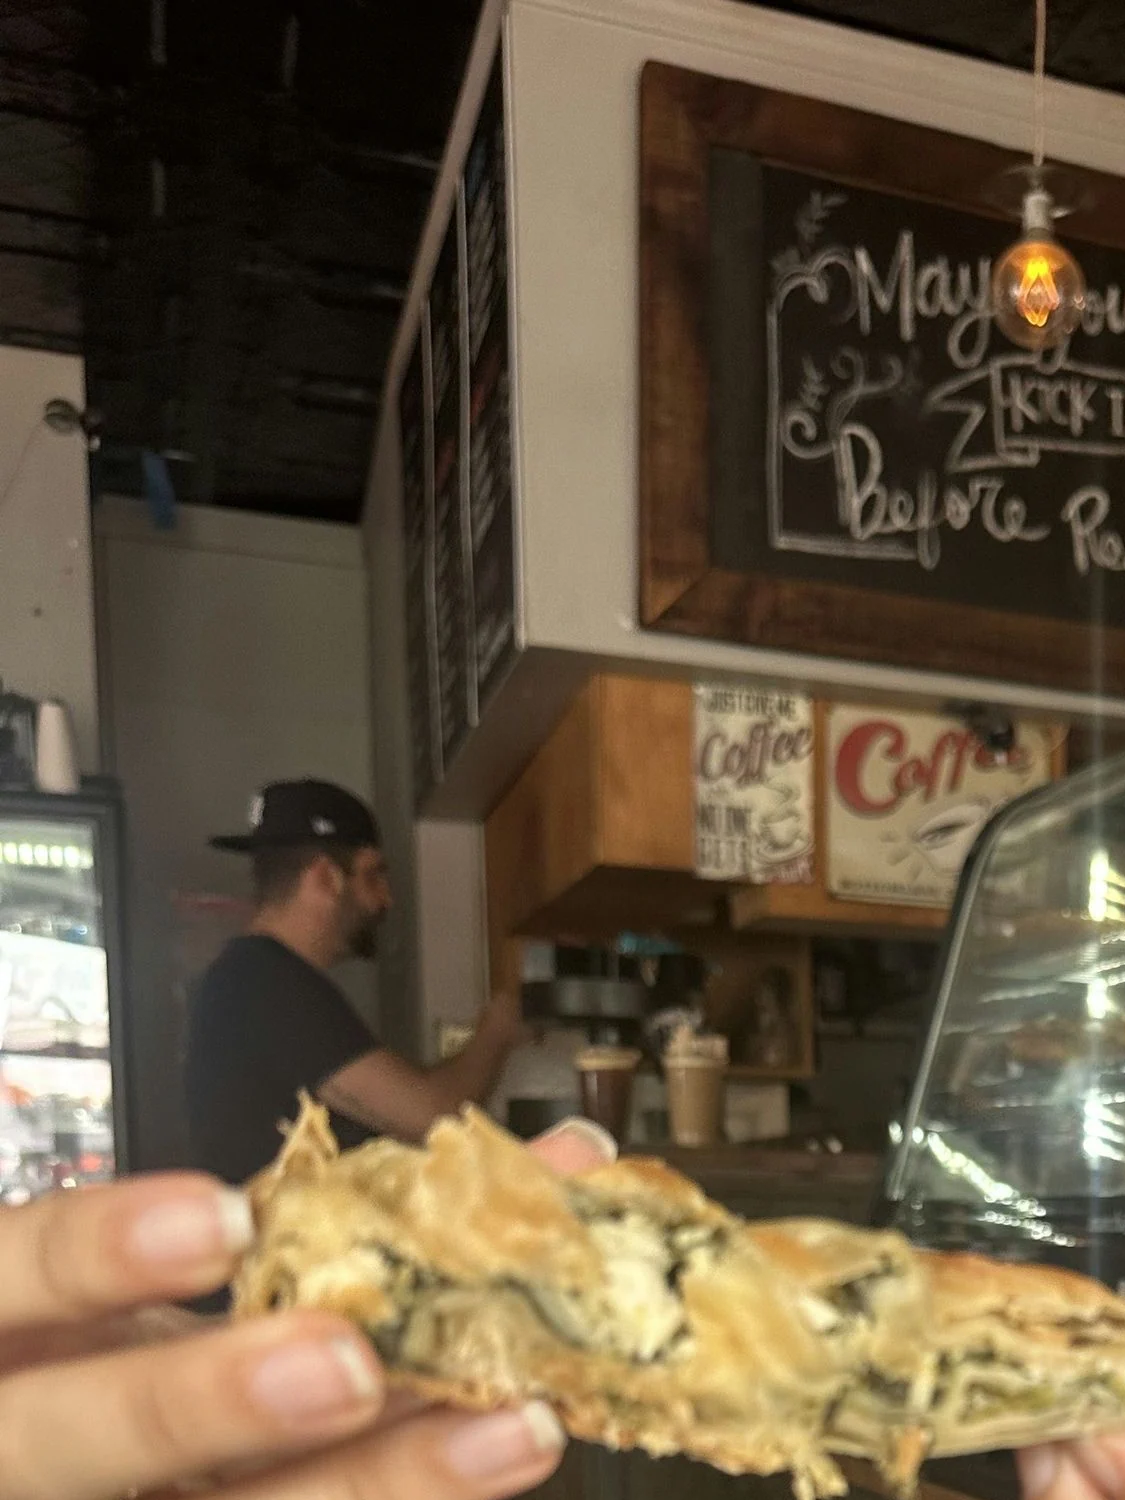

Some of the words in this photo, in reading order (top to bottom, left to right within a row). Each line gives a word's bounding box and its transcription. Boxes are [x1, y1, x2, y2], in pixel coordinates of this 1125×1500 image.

[854, 229, 994, 369] May
[1008, 371, 1097, 433] KICK
[834, 423, 1050, 569] Before
[700, 719, 813, 787] Coffee
